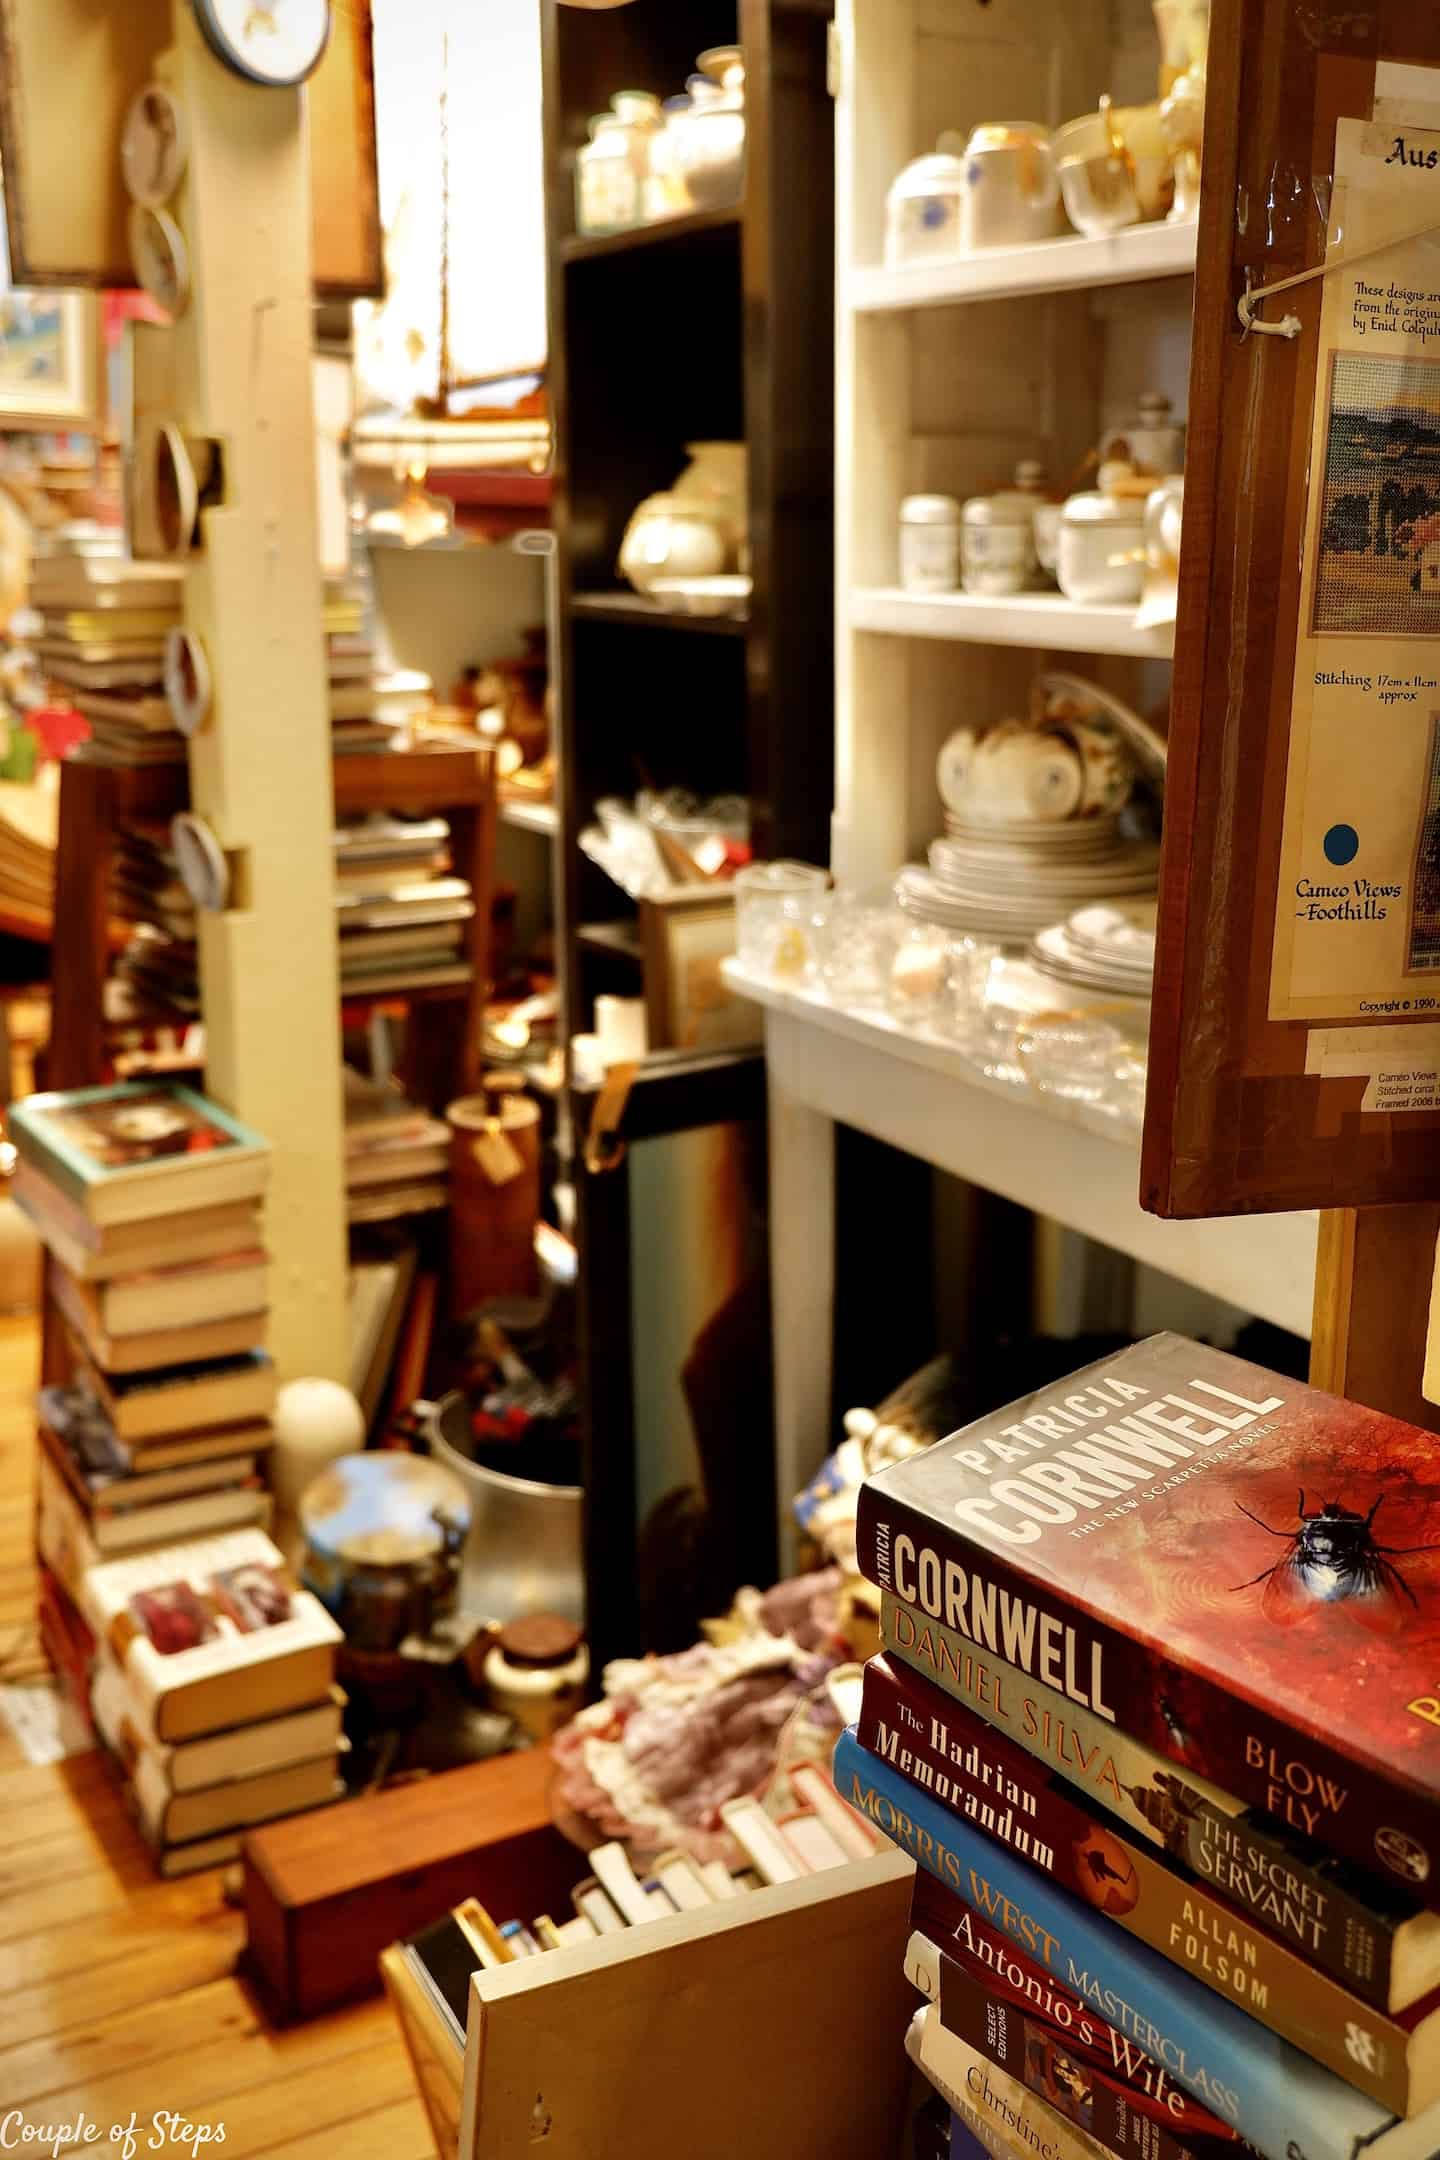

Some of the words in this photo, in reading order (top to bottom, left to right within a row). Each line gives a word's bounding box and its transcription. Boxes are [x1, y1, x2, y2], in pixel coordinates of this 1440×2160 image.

[1385, 136, 1438, 169] Aus
[1353, 314, 1366, 335] by
[1370, 316, 1397, 332] Enid
[1354, 281, 1384, 296] These
[1387, 281, 1425, 304] designs
[1354, 299, 1381, 313] from
[1385, 300, 1400, 315] the
[1314, 670, 1372, 692] Stitching
[1378, 690, 1418, 704] approx
[1296, 879, 1349, 898] Cameo
[1353, 879, 1402, 898] Views
[1360, 1000, 1400, 1013] Copyright
[952, 1377, 1150, 1475] PATRICIA
[954, 1379, 1286, 1544] CORNWELL
[1068, 1519, 1104, 1539] THE
[1104, 1500, 1139, 1521] NEW
[1142, 1451, 1227, 1501] SCARPETTA
[1231, 1422, 1281, 1452] NOVEL
[877, 1522, 893, 1591] PATRICIA
[894, 1533, 1116, 1723] CORNWELL
[894, 1606, 1009, 1719] DANIEL
[1023, 1698, 1122, 1802] SILVA
[874, 1720, 1055, 1872] Memorandum
[896, 1702, 924, 1734] The
[928, 1715, 1037, 1818] Hadrian
[1245, 1735, 1347, 1813] BLOW
[1267, 1785, 1320, 1836] FLY
[1199, 1839, 1328, 1950] SERVANT
[1201, 1812, 1241, 1861] THE
[1247, 1847, 1328, 1917] SECRET
[852, 1775, 961, 1889] MORRIS
[968, 1866, 1061, 1966] WEST
[1066, 1957, 1241, 2119] MASTERCLASS
[1169, 1922, 1268, 2009] FOLSOM
[1182, 1899, 1257, 1968] ALLAN
[952, 1912, 1095, 2046] Antonio's
[1106, 2023, 1186, 2119] Wife
[986, 2001, 997, 2047] SELECT
[998, 2005, 1009, 2061] EDITIONS
